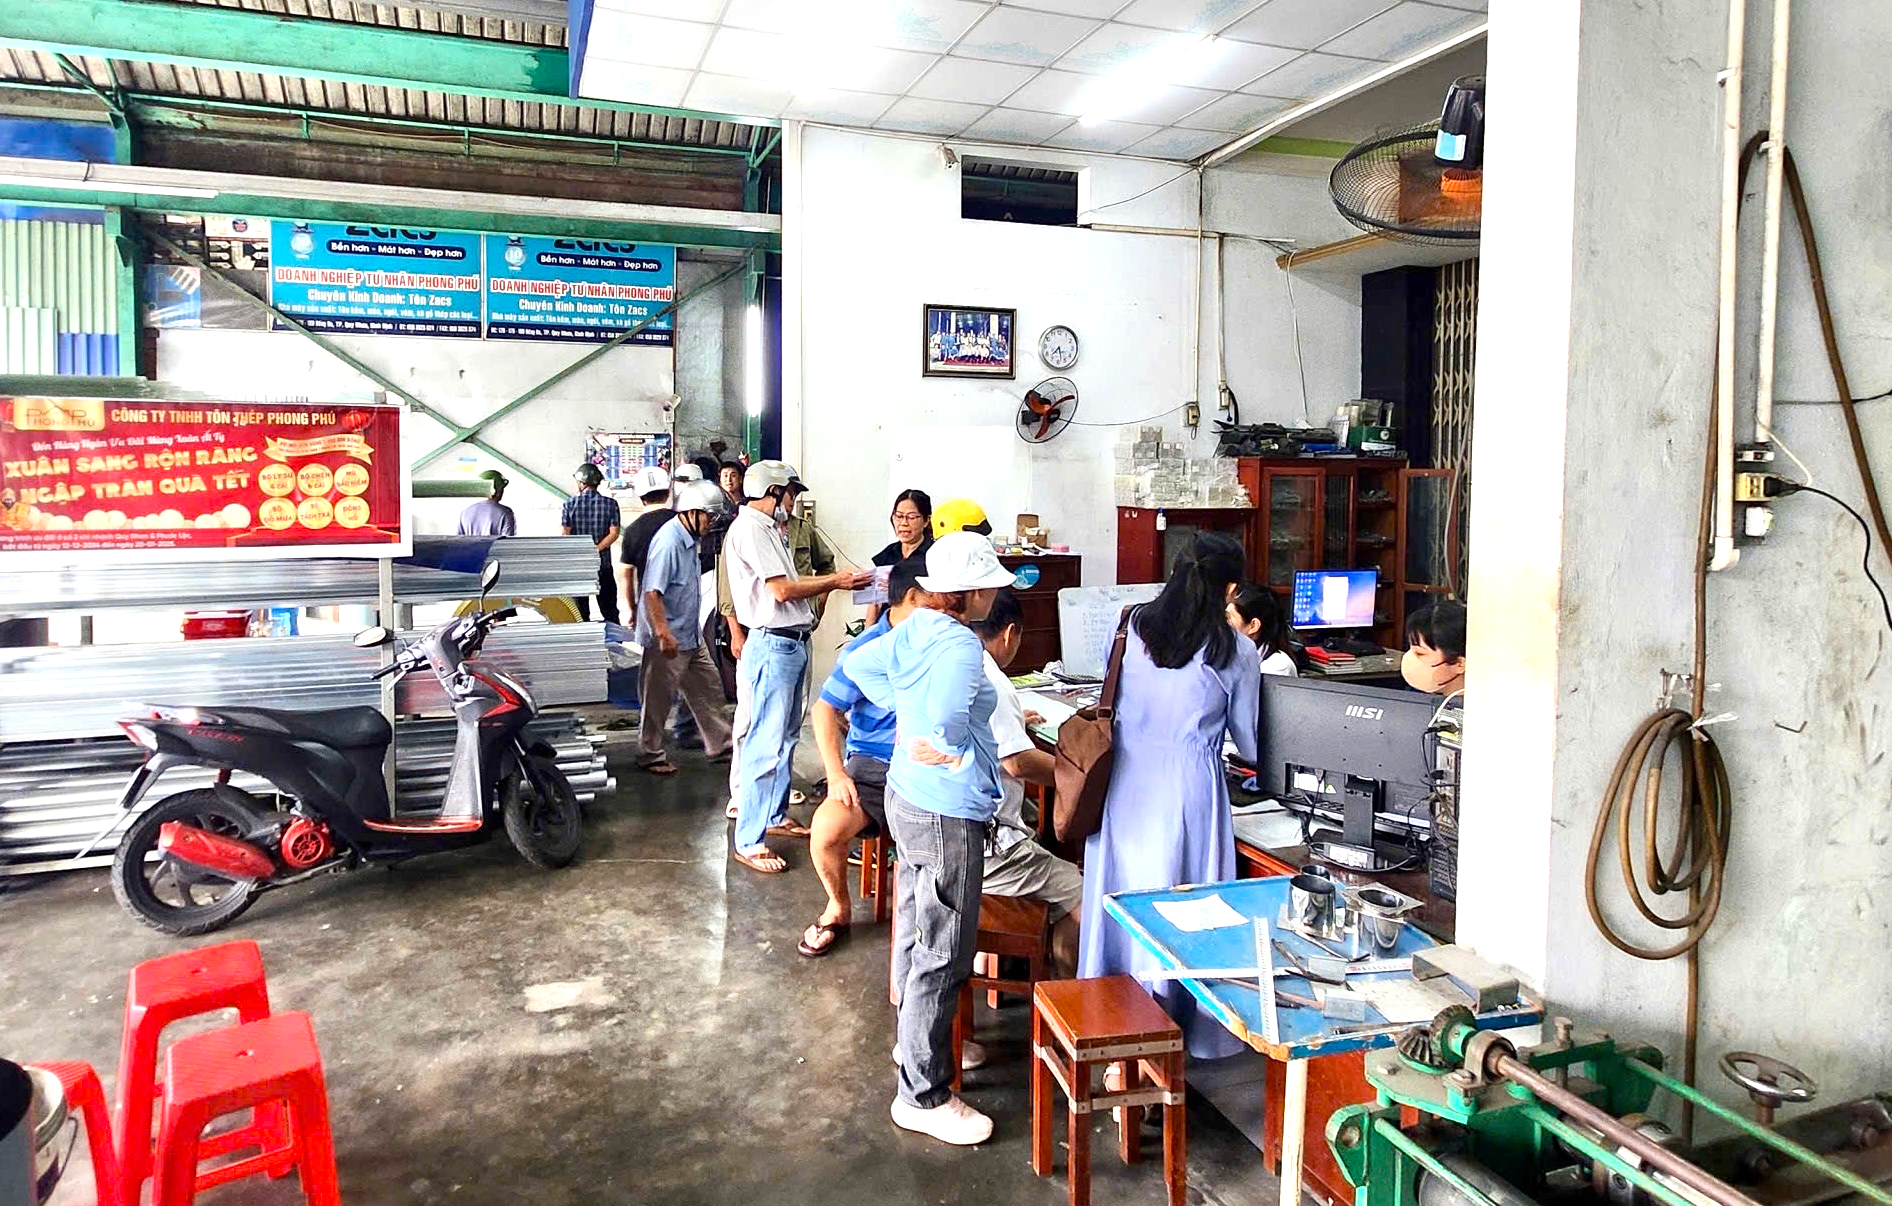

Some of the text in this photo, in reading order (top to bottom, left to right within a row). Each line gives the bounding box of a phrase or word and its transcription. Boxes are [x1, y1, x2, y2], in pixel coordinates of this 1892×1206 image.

[331, 242, 350, 252] Bền
[351, 243, 370, 254] hơn
[378, 245, 399, 255] Mát
[400, 246, 416, 256] hơn
[424, 248, 443, 259] Đẹp
[445, 248, 463, 258] hơn
[540, 255, 557, 264] Bền
[559, 256, 575, 265] hơn
[582, 258, 599, 266] Mát
[600, 259, 616, 267] hơn
[624, 260, 641, 270] Đẹp
[642, 261, 658, 270] hơn
[277, 268, 479, 290] DOANH NGHIỆP TƯ NHÂN PHONG PHÚ
[307, 288, 453, 307] Chuyên Kinh Doanh: Tôn Zacs
[492, 279, 673, 301] DOANH NGHIỆP TƯ NHÂN PHONG PHÚ
[518, 299, 648, 316] Chuyên Kinh Doanh: Tôn Zacs
[111, 407, 148, 423] CÔNG
[151, 410, 167, 423] TY
[169, 410, 203, 424] TNHH
[206, 408, 230, 424] TÔN
[267, 411, 309, 425] PHONG
[312, 410, 336, 425] PHÚ
[4, 446, 258, 479] XUÂN SANG RỘN RÀNG
[20, 469, 251, 504] NGẬP TRÀN QUÀ TẾT
[1345, 705, 1384, 720] MSI
